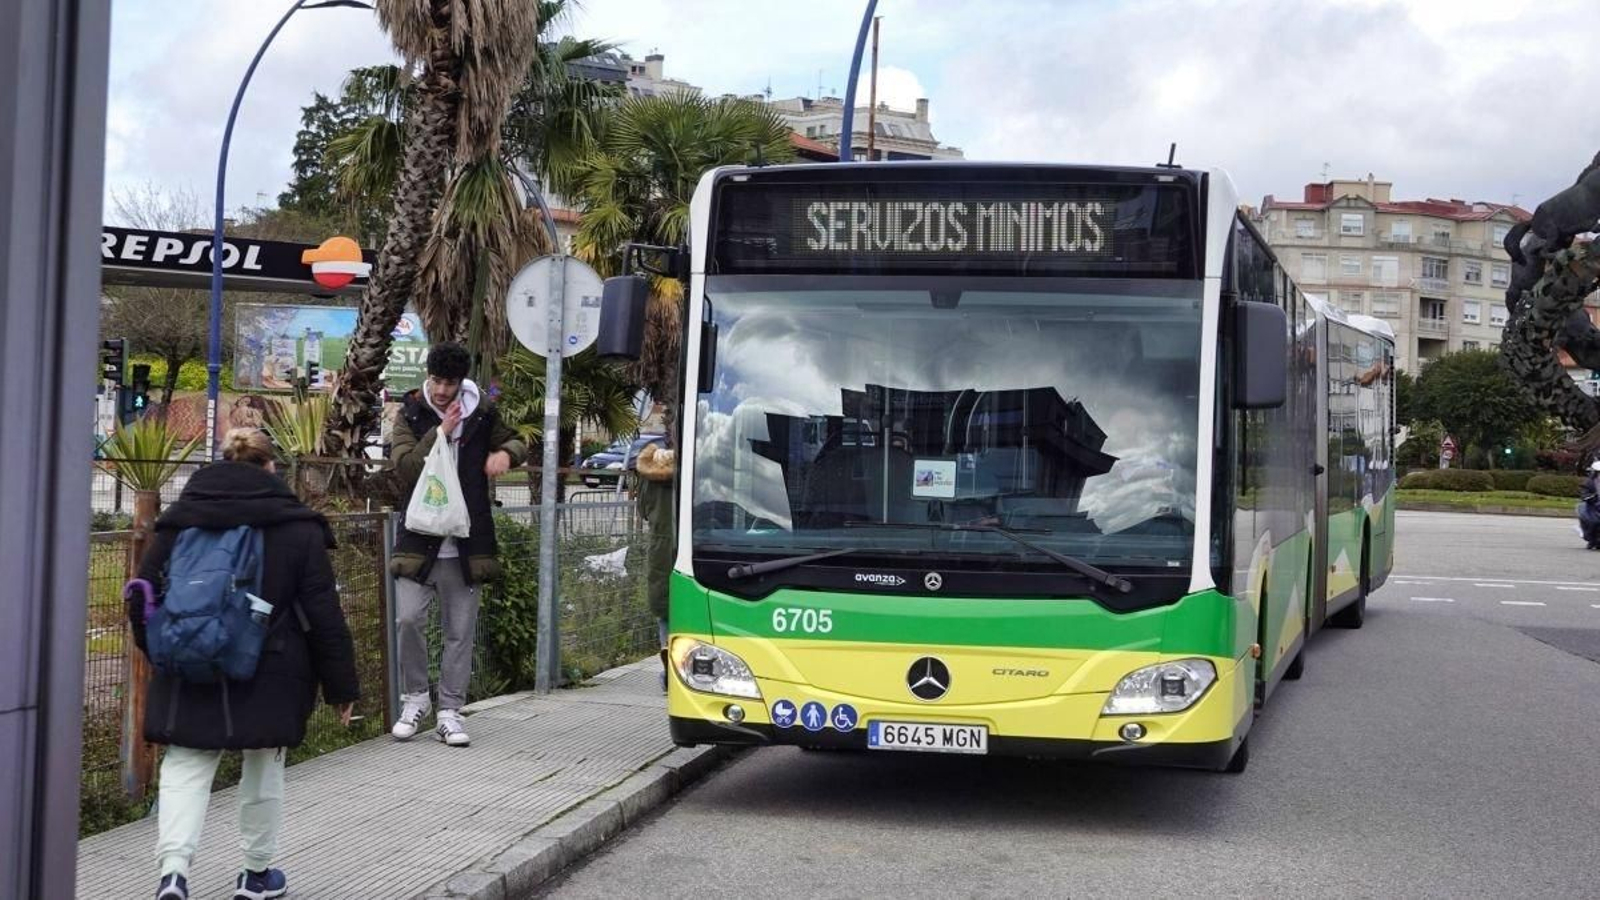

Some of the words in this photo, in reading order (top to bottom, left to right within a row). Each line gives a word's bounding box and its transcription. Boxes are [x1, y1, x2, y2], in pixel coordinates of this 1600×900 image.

[807, 202, 968, 250] SERVIZOS
[977, 202, 1104, 251] MINIMOS
[101, 232, 263, 270] REPSOL
[855, 573, 896, 583] avanza
[773, 607, 833, 633] 6705
[992, 668, 1050, 677] CITARO
[884, 725, 936, 746] 6645
[942, 727, 981, 748] MGN
